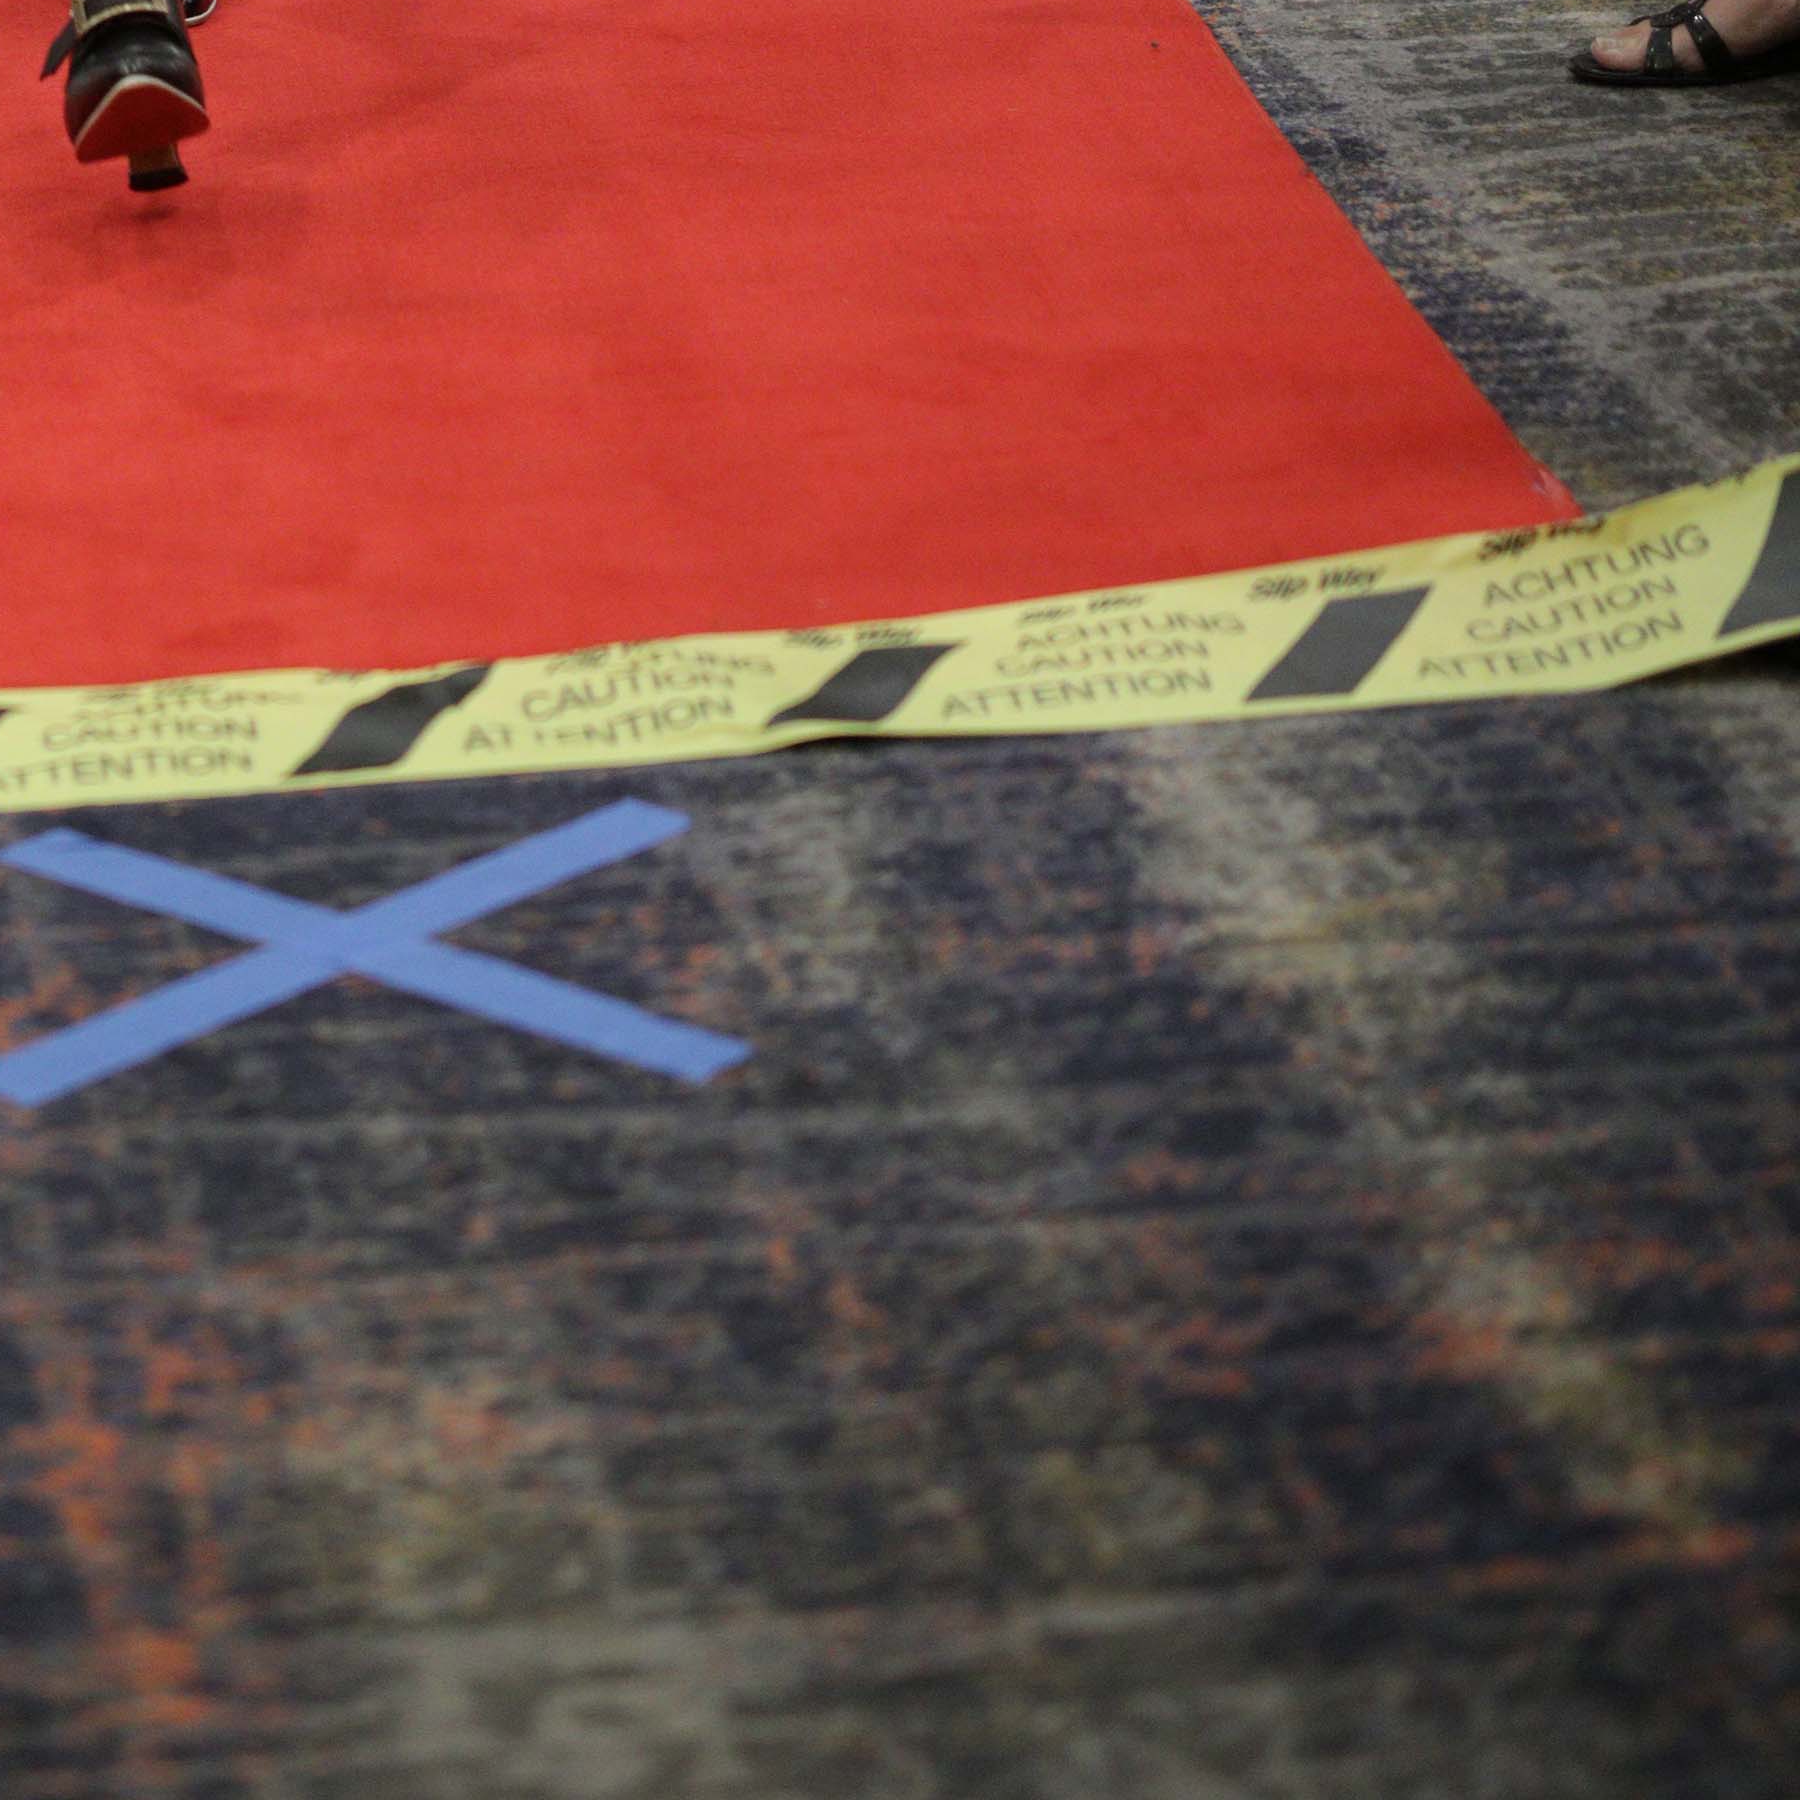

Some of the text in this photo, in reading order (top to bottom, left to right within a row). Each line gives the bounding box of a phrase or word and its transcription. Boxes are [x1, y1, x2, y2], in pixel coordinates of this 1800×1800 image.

[1481, 523, 1711, 609] ACHTUNG
[1014, 611, 1247, 655] ACHTUNG
[1465, 574, 1677, 645] CAUTION
[993, 639, 1210, 679] CAUTION
[1416, 609, 1685, 681] ATTENTION
[520, 659, 736, 722] CAUTION
[936, 667, 1213, 723] ATTENTION
[42, 714, 259, 753] CAUTION
